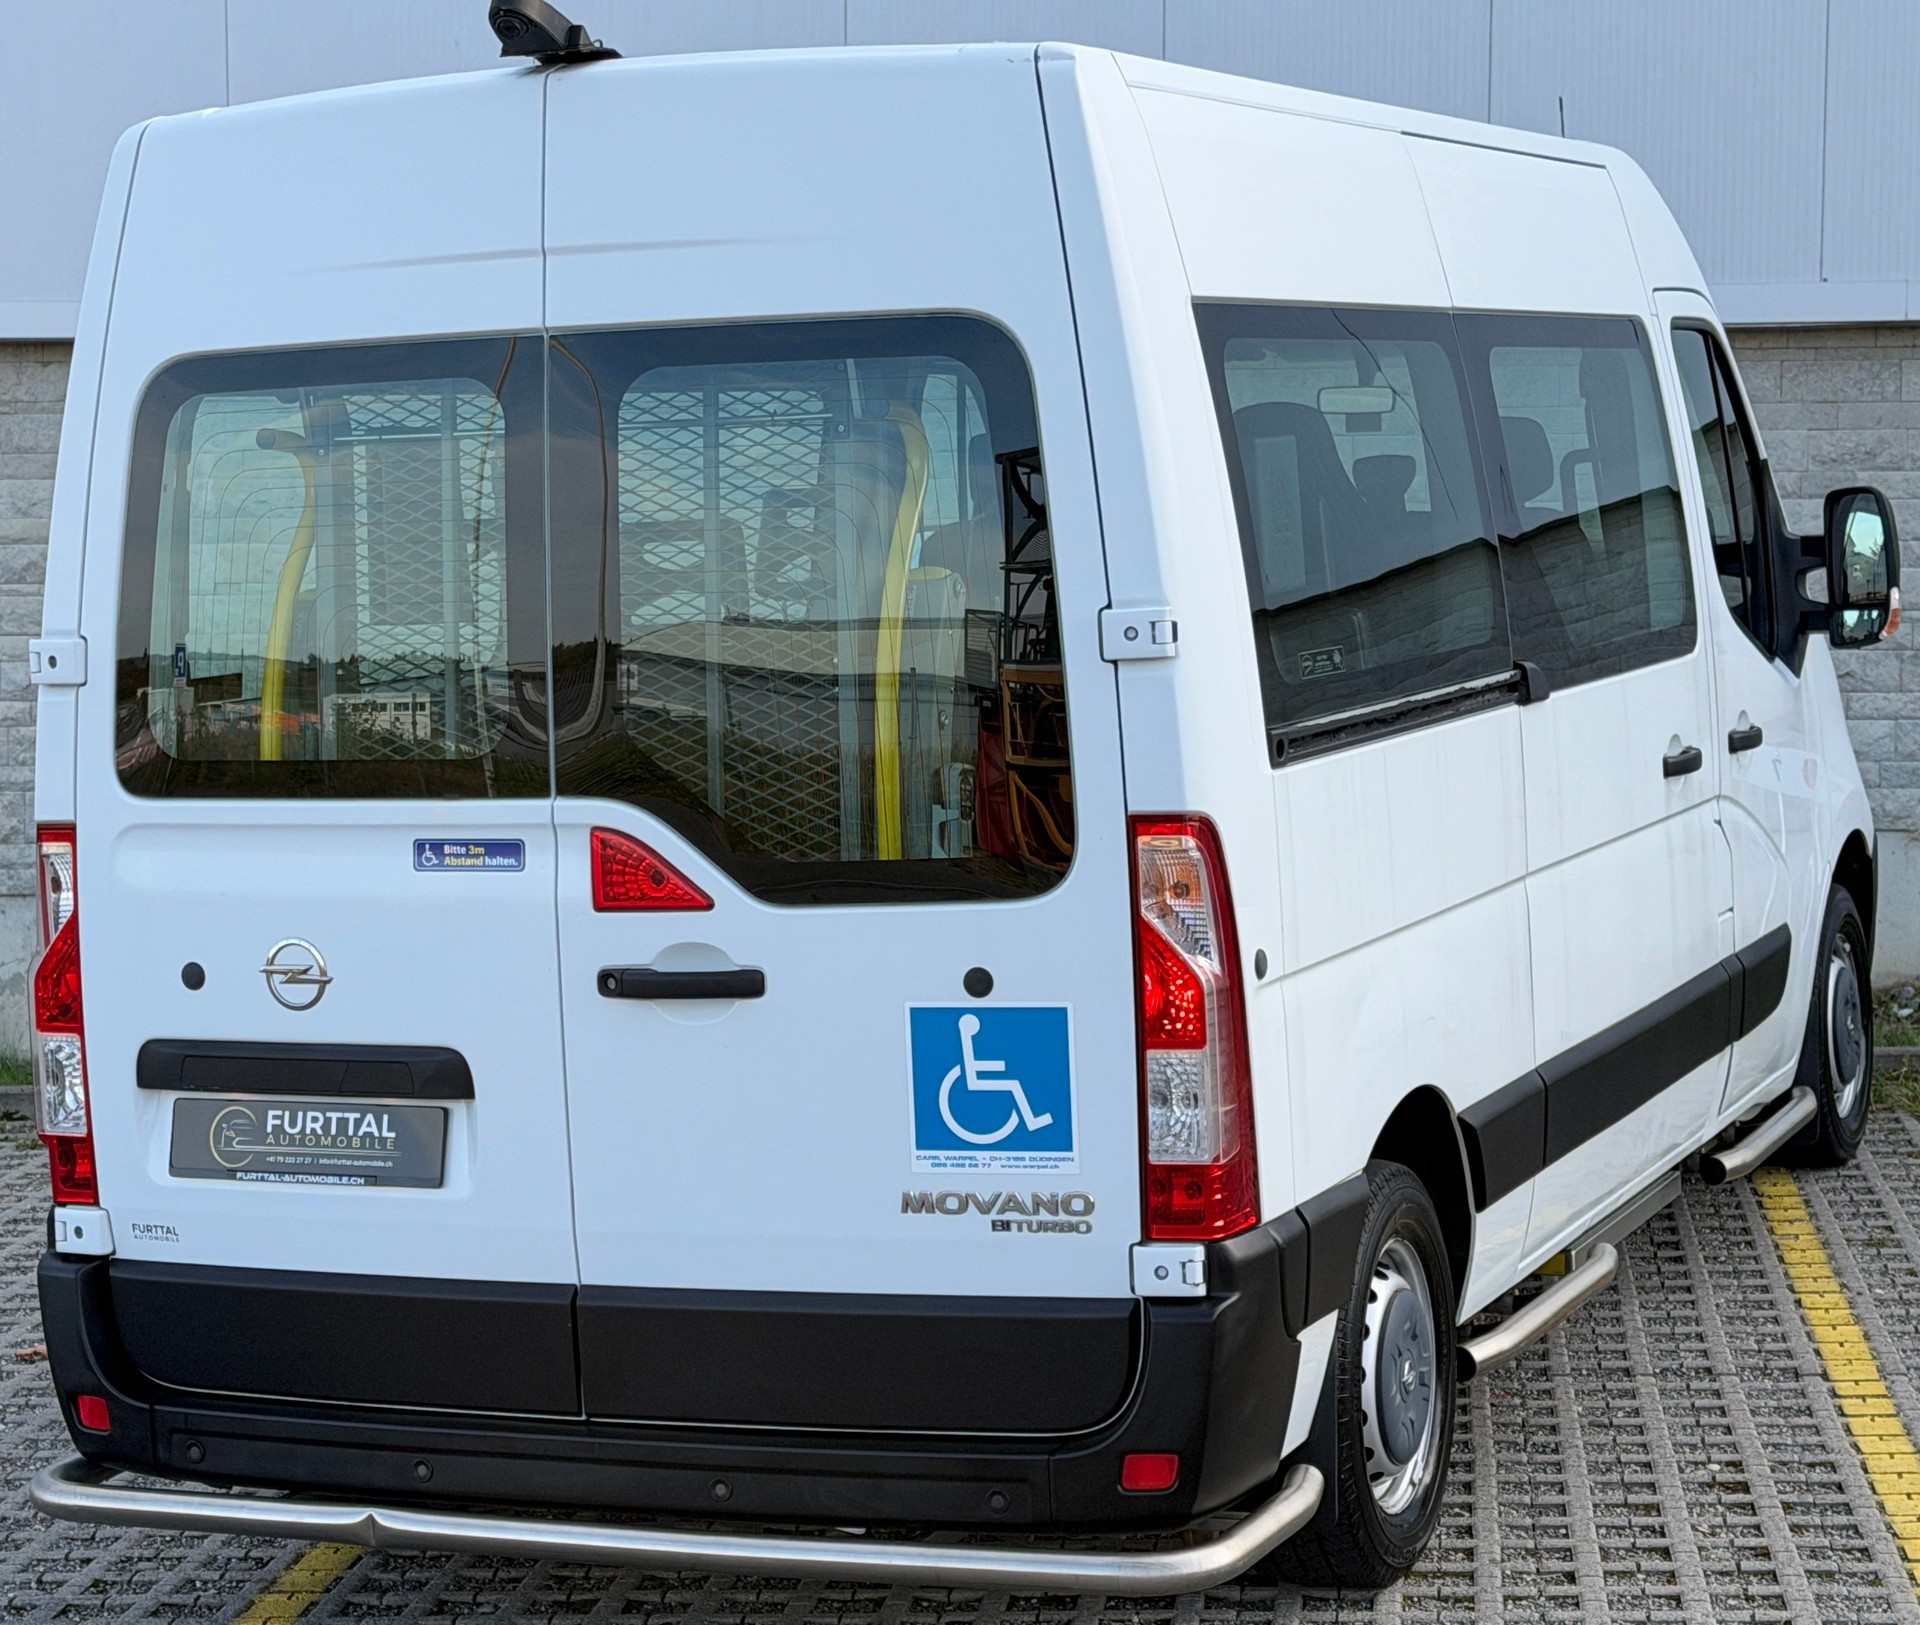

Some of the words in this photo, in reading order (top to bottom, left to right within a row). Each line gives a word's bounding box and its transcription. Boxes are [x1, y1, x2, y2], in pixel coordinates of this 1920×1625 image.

[443, 844, 466, 854] Bitte
[468, 845, 485, 855] 3m
[443, 856, 483, 866] Abstand
[485, 856, 518, 866] halten.
[266, 1110, 396, 1138] FURTTAL
[266, 1134, 396, 1150] AUTOMOBILE
[236, 1172, 364, 1185] FURTTAL-AUTOMOBILE.CH
[901, 1190, 1095, 1217] MOVANO
[131, 1223, 179, 1236] FURTTAL
[991, 1218, 1093, 1235] BITURBO
[134, 1234, 180, 1243] AUTOMOBILE
